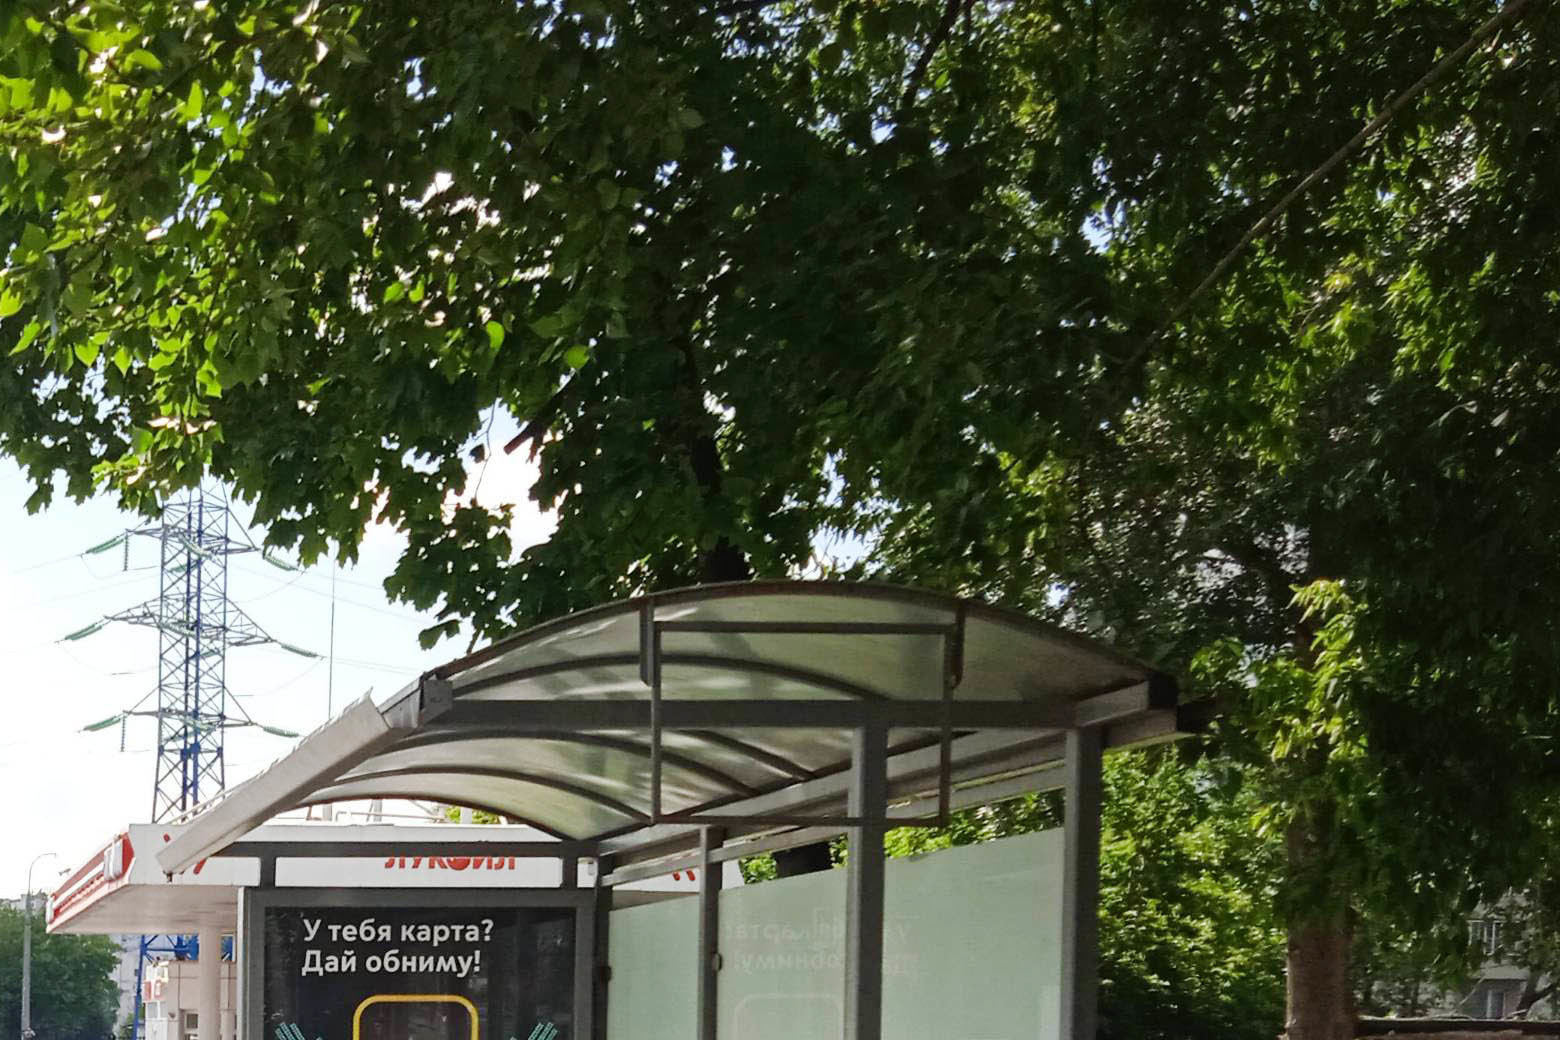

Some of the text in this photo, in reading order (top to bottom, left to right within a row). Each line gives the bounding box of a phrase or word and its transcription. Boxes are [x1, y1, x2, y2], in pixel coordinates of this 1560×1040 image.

[303, 918, 494, 947] У тебя карта?
[301, 949, 481, 978] Дай обниму!
